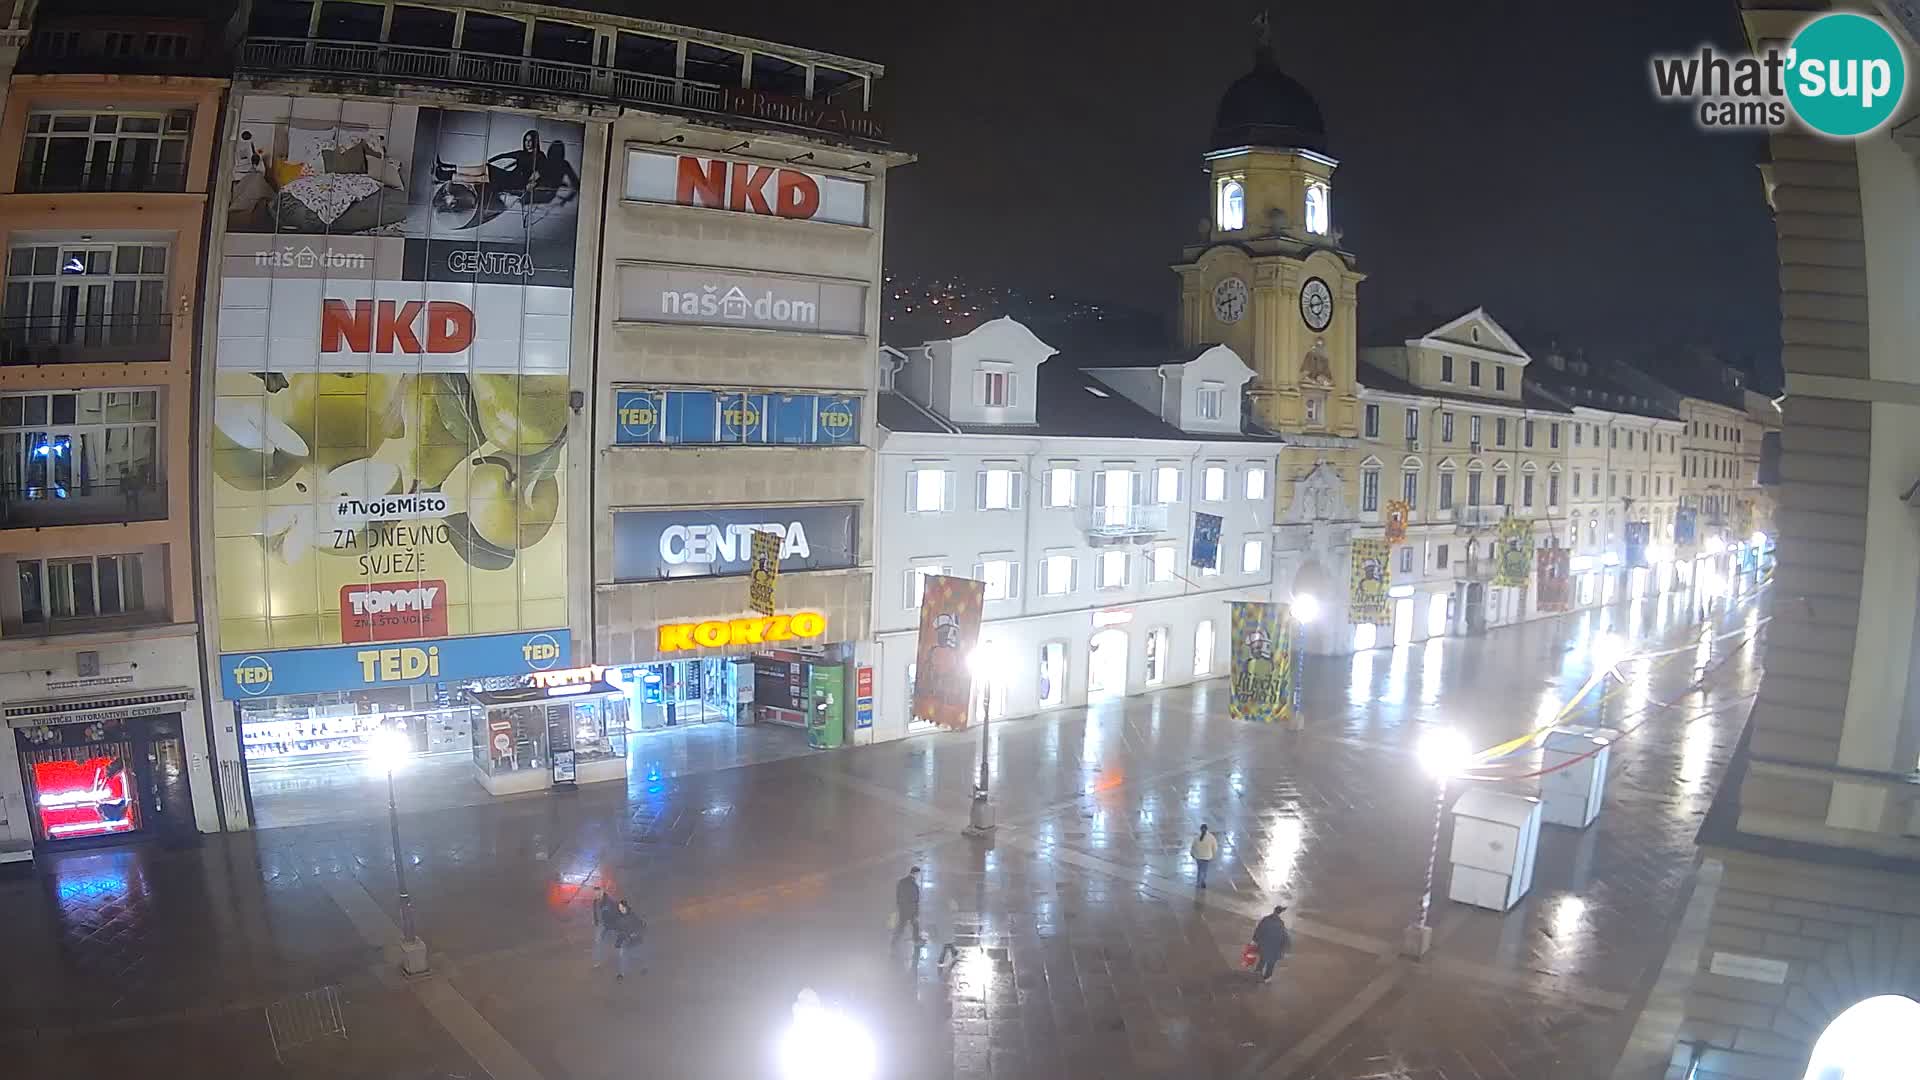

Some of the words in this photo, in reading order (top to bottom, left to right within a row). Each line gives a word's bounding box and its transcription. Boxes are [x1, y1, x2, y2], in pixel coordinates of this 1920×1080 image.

[676, 155, 820, 220] NKD
[255, 247, 295, 268] naš
[319, 247, 365, 270] dom
[448, 251, 534, 276] CENTRA
[662, 284, 718, 317] naš
[753, 291, 816, 323] dom
[321, 299, 476, 354] NKD
[619, 409, 658, 425] TEDi
[724, 410, 760, 426] TEDi
[820, 412, 853, 427] TEDi
[337, 498, 446, 517] #TvojeMisto
[333, 529, 357, 549] ZA
[367, 524, 450, 548] DNEVNO
[360, 547, 426, 576] SVJEŽE
[348, 587, 439, 615] TOMMY
[658, 612, 826, 652] KORZO
[357, 646, 440, 682] TEDi
[522, 643, 560, 661] TEDi
[233, 667, 273, 684] TEDi
[533, 664, 606, 688] TOMMY
